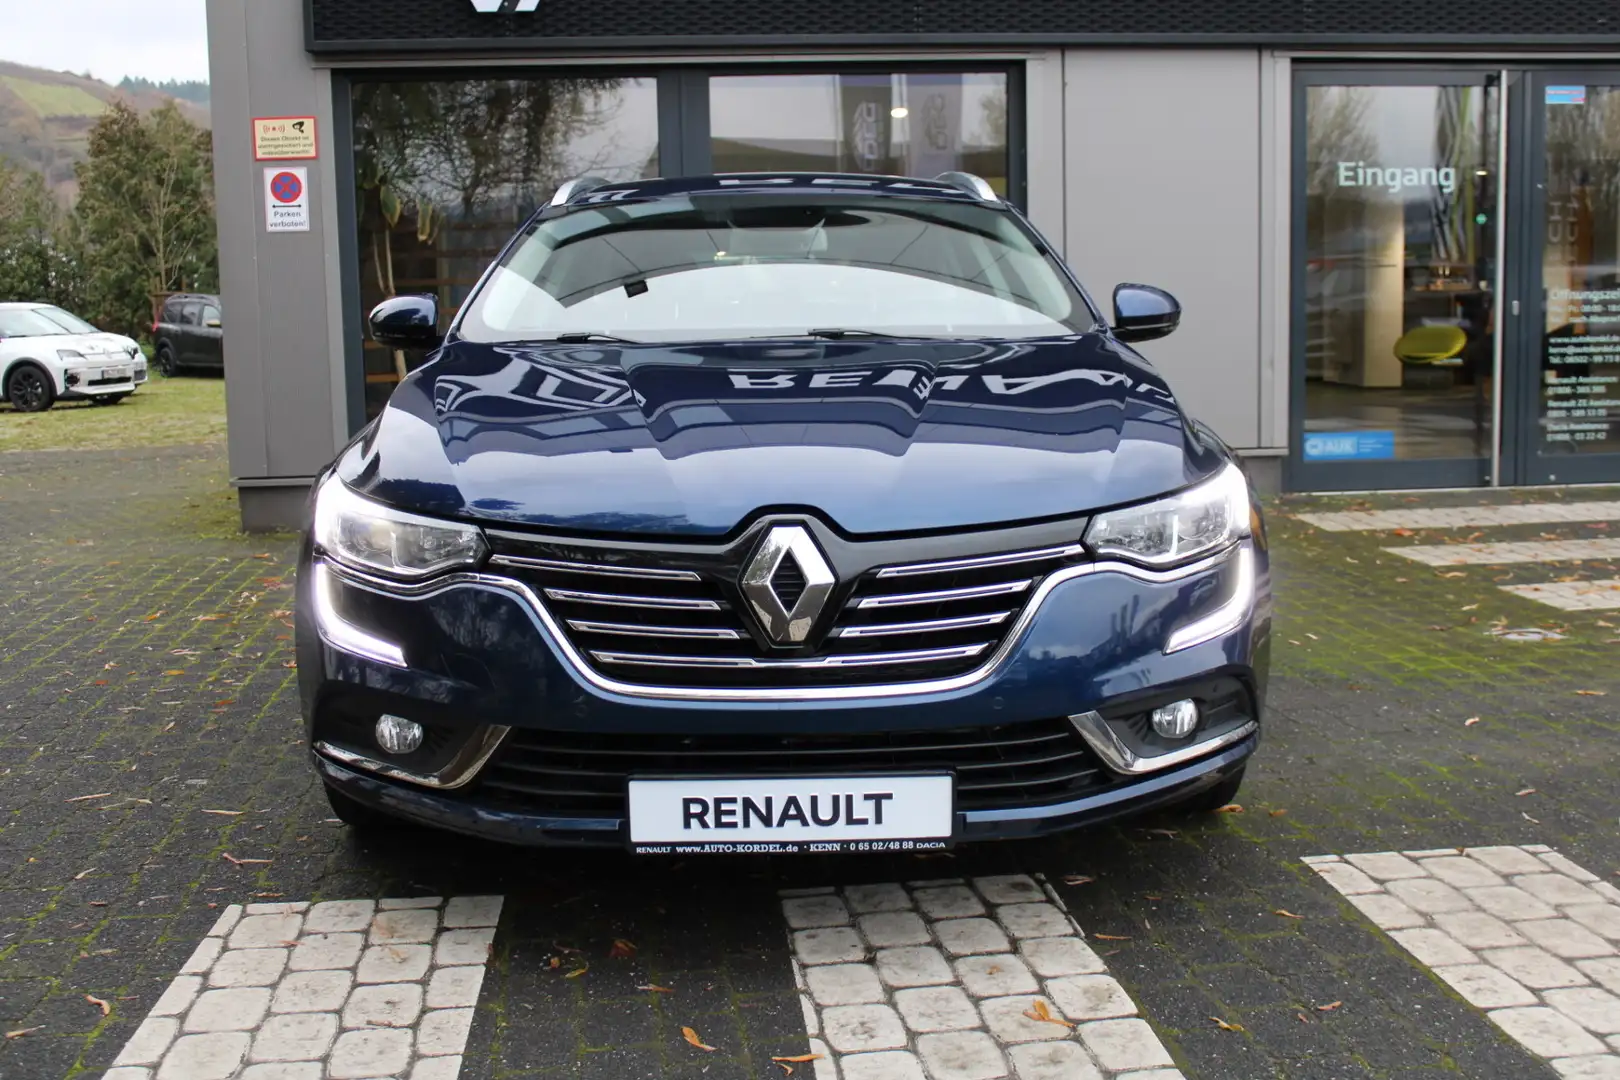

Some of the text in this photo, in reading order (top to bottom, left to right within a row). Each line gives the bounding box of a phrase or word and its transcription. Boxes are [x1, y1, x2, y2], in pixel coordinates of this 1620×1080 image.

[1338, 161, 1456, 193] Eingang
[682, 792, 894, 829] RENAULT
[636, 846, 671, 854] RENAULT
[675, 843, 799, 853] www.AUTO-KORDEL.de
[809, 843, 841, 851] KENN
[850, 842, 856, 850] 0
[858, 842, 870, 850] 65
[872, 841, 900, 850] 02/48
[902, 841, 914, 849] 88
